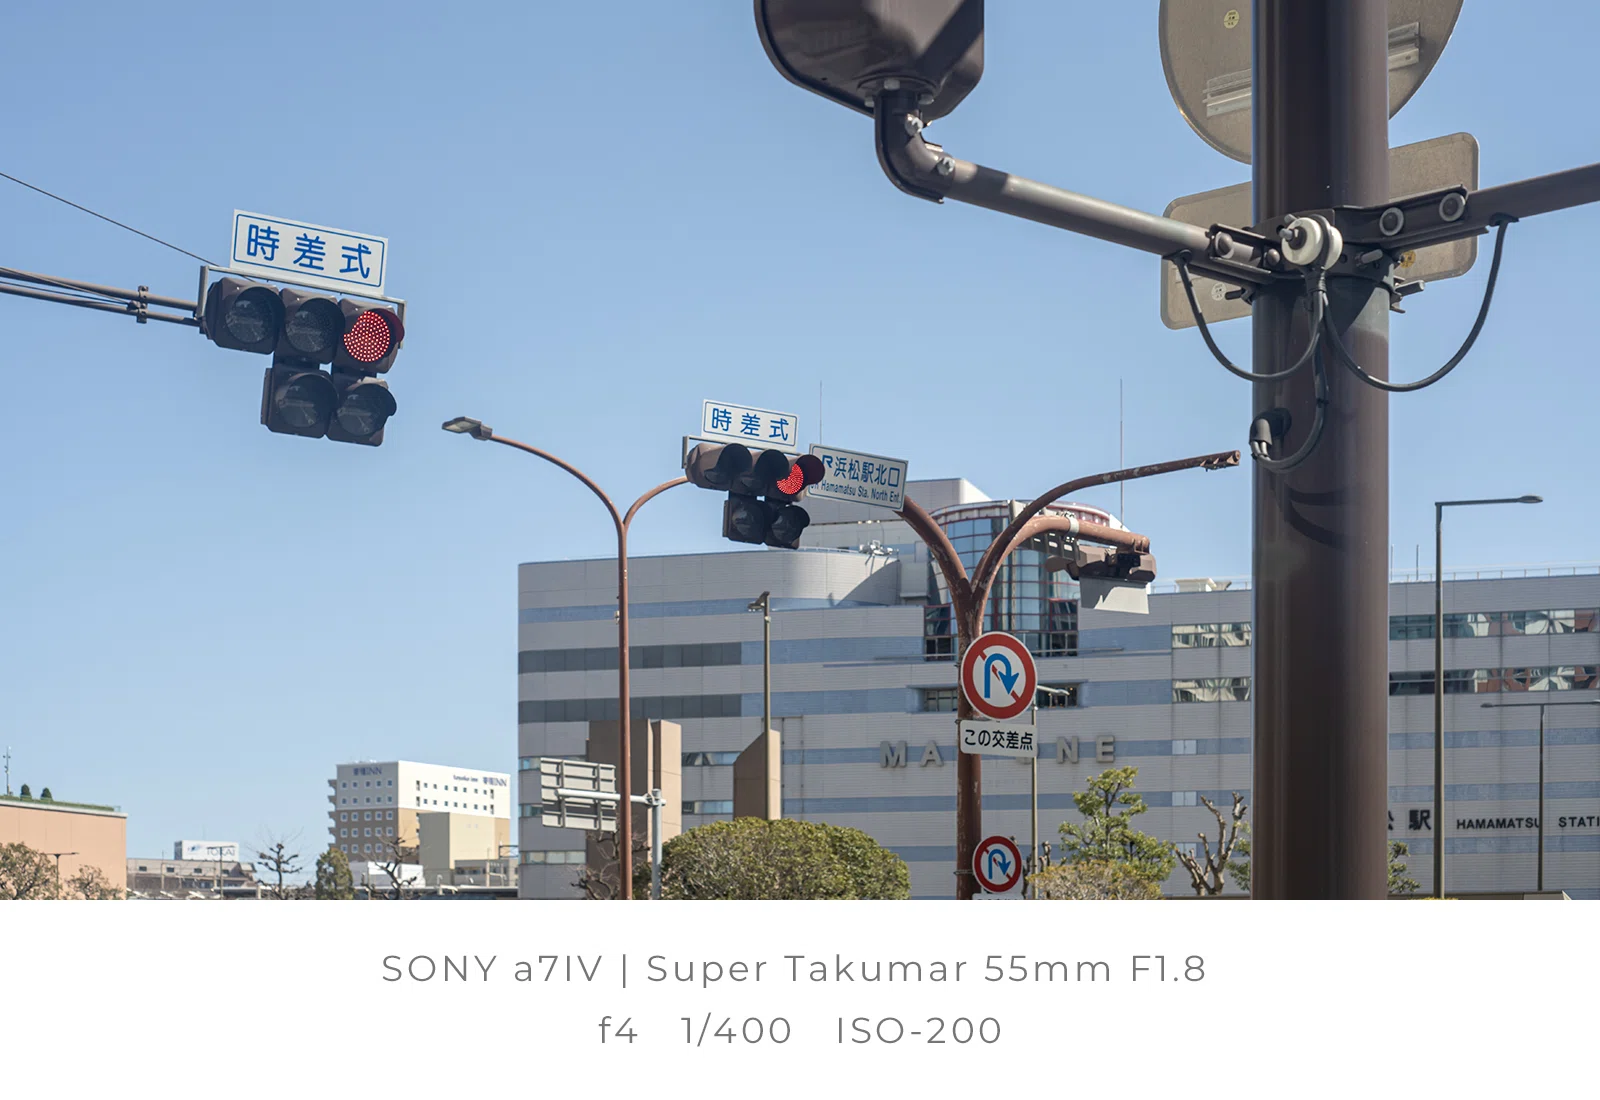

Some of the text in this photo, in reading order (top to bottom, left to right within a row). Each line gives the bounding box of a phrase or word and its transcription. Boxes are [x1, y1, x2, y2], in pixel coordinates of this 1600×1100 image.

[247, 224, 372, 279] 時差式
[711, 407, 789, 441] 時差式
[822, 454, 900, 487] R浜松駅北口
[821, 480, 857, 496] Hamamatsu
[857, 485, 869, 499] Sta.
[871, 487, 888, 502] North
[879, 740, 944, 768] MA
[964, 729, 1033, 751] この交差点
[1457, 816, 1600, 829] HAMAMATSU STATI
